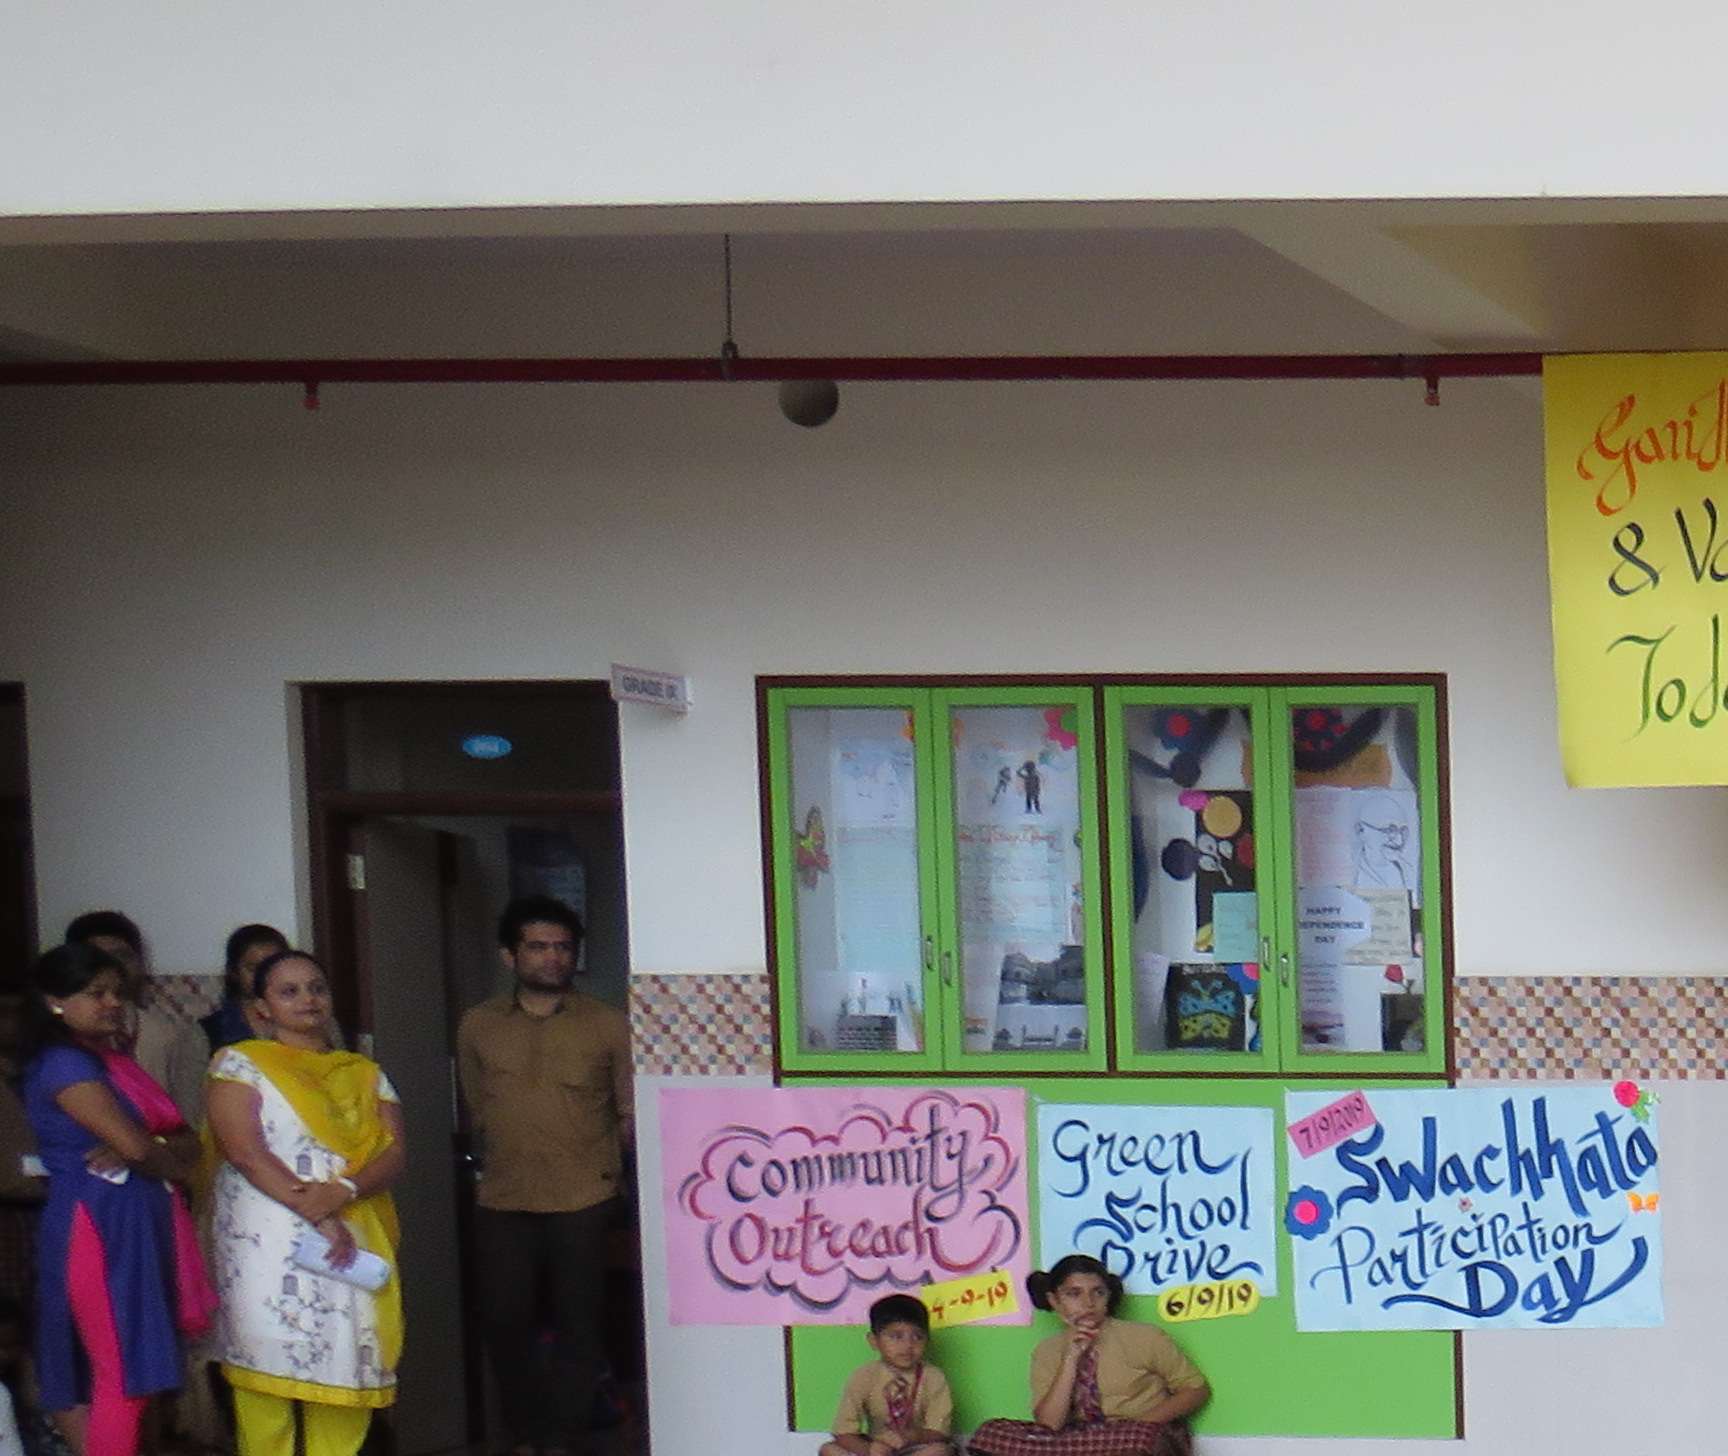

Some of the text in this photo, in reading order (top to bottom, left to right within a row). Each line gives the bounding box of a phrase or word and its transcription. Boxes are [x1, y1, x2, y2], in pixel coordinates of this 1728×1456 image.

[1608, 519, 1666, 598] &
[1306, 906, 1342, 915] HAPPY
[1314, 935, 1336, 944] DAY
[726, 1103, 990, 1223] Community
[1049, 1119, 1240, 1198] Green
[1074, 1148, 1253, 1244] School
[1337, 1097, 1660, 1219] Swachhata
[728, 1192, 1000, 1274] Outreach
[1310, 1201, 1628, 1305] Participation
[1166, 1283, 1253, 1317] 6/9/19
